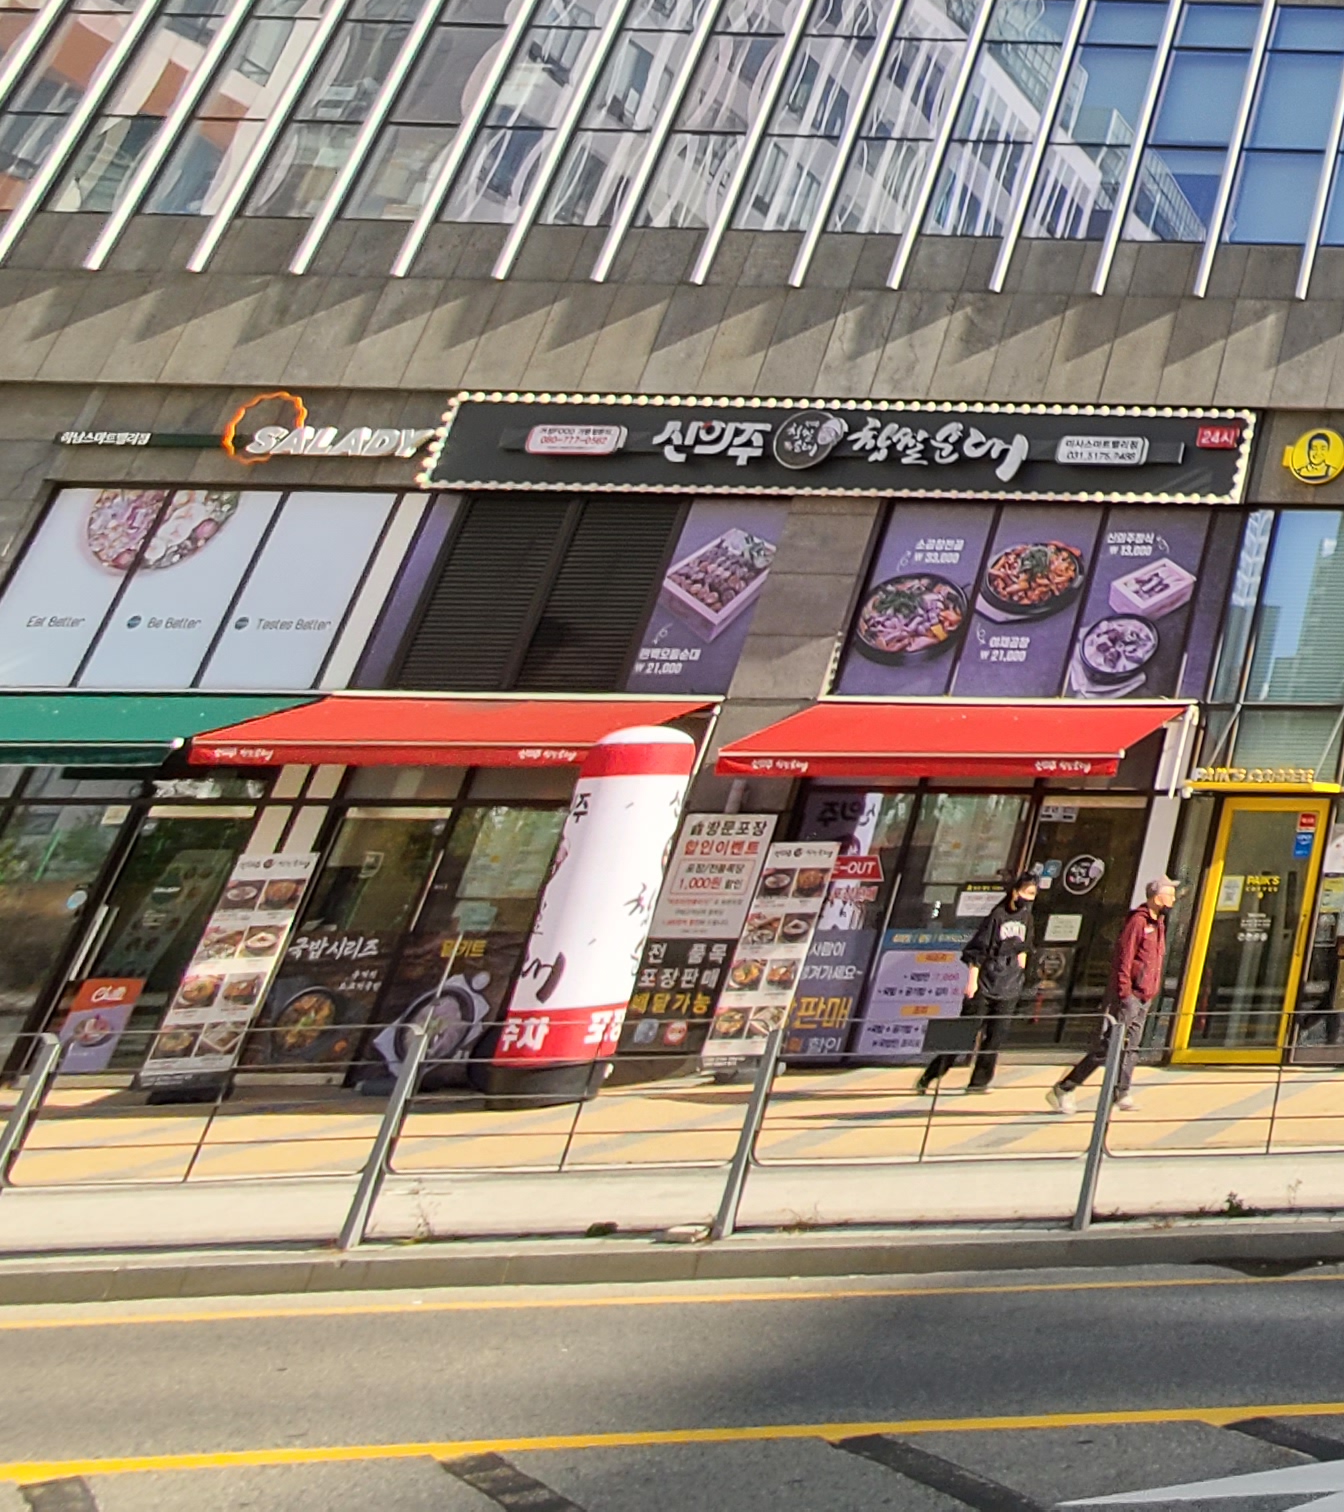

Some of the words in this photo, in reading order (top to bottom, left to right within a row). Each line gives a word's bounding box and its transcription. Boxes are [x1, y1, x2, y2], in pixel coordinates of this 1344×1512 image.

[246, 425, 434, 458] SALADY
[652, 420, 772, 466] 신의주
[1201, 431, 1235, 445] 24시
[847, 416, 1029, 483] 찹쌀순대
[706, 820, 768, 837] 방문포장
[684, 839, 760, 856] 할인이벤트
[647, 942, 668, 964] 전
[638, 967, 721, 989] 포장판매
[630, 991, 711, 1015] 배달가능
